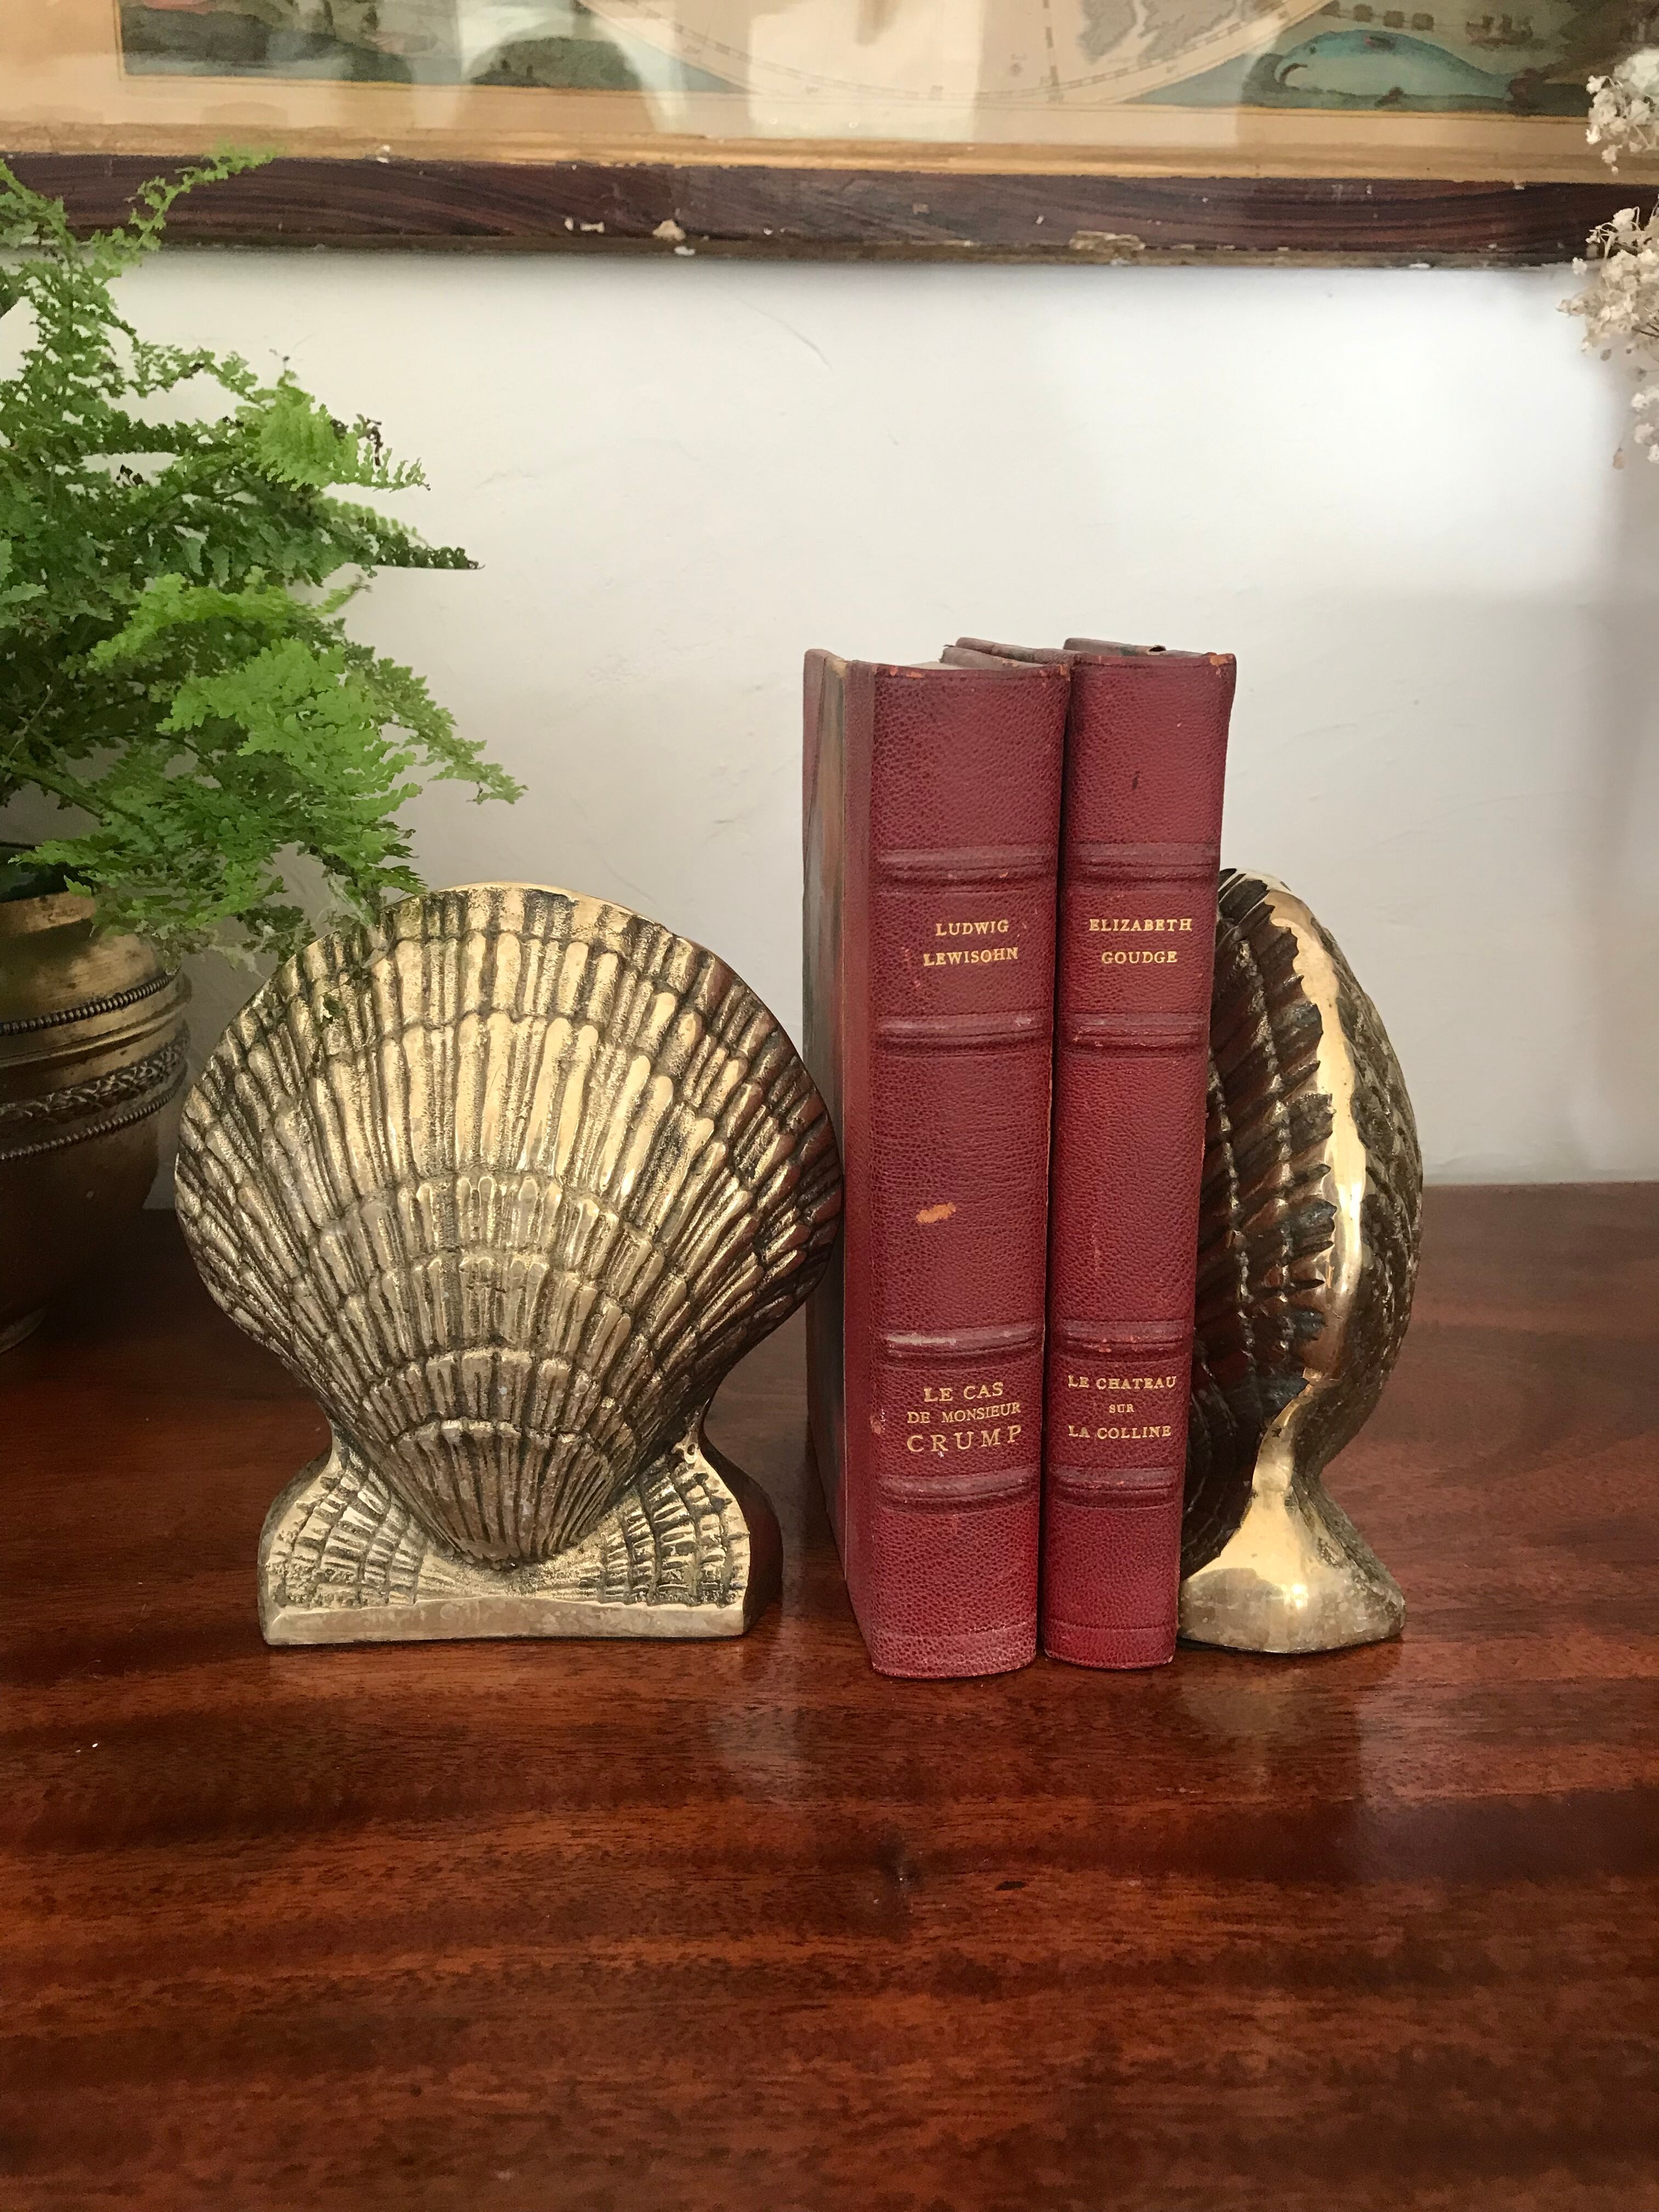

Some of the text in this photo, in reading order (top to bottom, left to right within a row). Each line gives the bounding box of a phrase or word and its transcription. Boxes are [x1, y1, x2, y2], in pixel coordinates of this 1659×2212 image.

[935, 919, 1010, 936] LUDWIG
[1088, 918, 1193, 932] ELIZABETH
[923, 946, 1019, 967] LEWISOHN
[1101, 951, 1178, 964] GOUDGE
[1068, 1375, 1177, 1390] LE CHATEAU
[923, 1381, 1004, 1402] LE CAS
[907, 1402, 1021, 1424] DE MONSIEUR
[1109, 1403, 1135, 1414] SUR
[906, 1425, 1022, 1452] CRUMP
[1068, 1425, 1172, 1440] LA COLLINE
